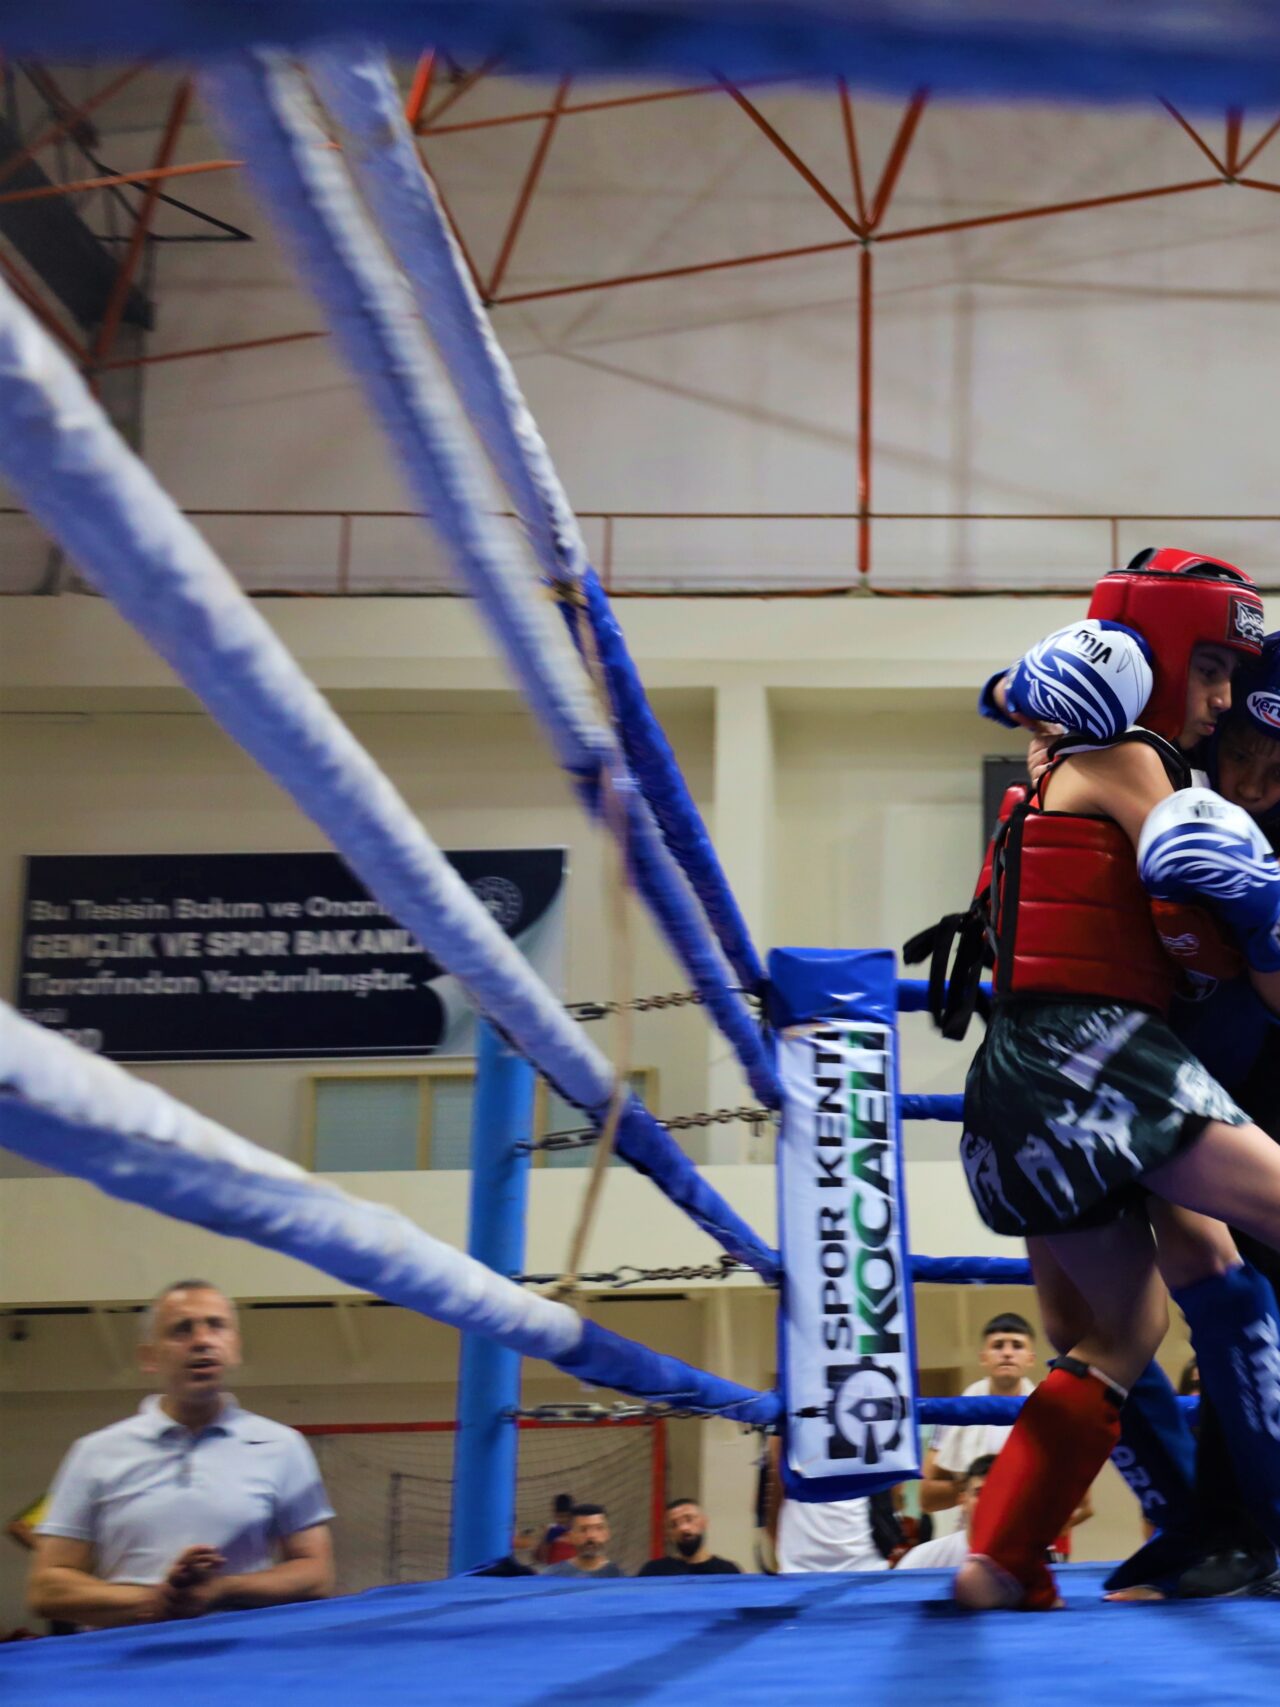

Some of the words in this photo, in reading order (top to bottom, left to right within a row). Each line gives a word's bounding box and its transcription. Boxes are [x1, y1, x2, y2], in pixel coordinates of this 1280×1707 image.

[266, 902, 301, 918] ve
[158, 931, 203, 957] VE
[205, 931, 290, 956] SPOR
[819, 1206, 852, 1351] SPOR
